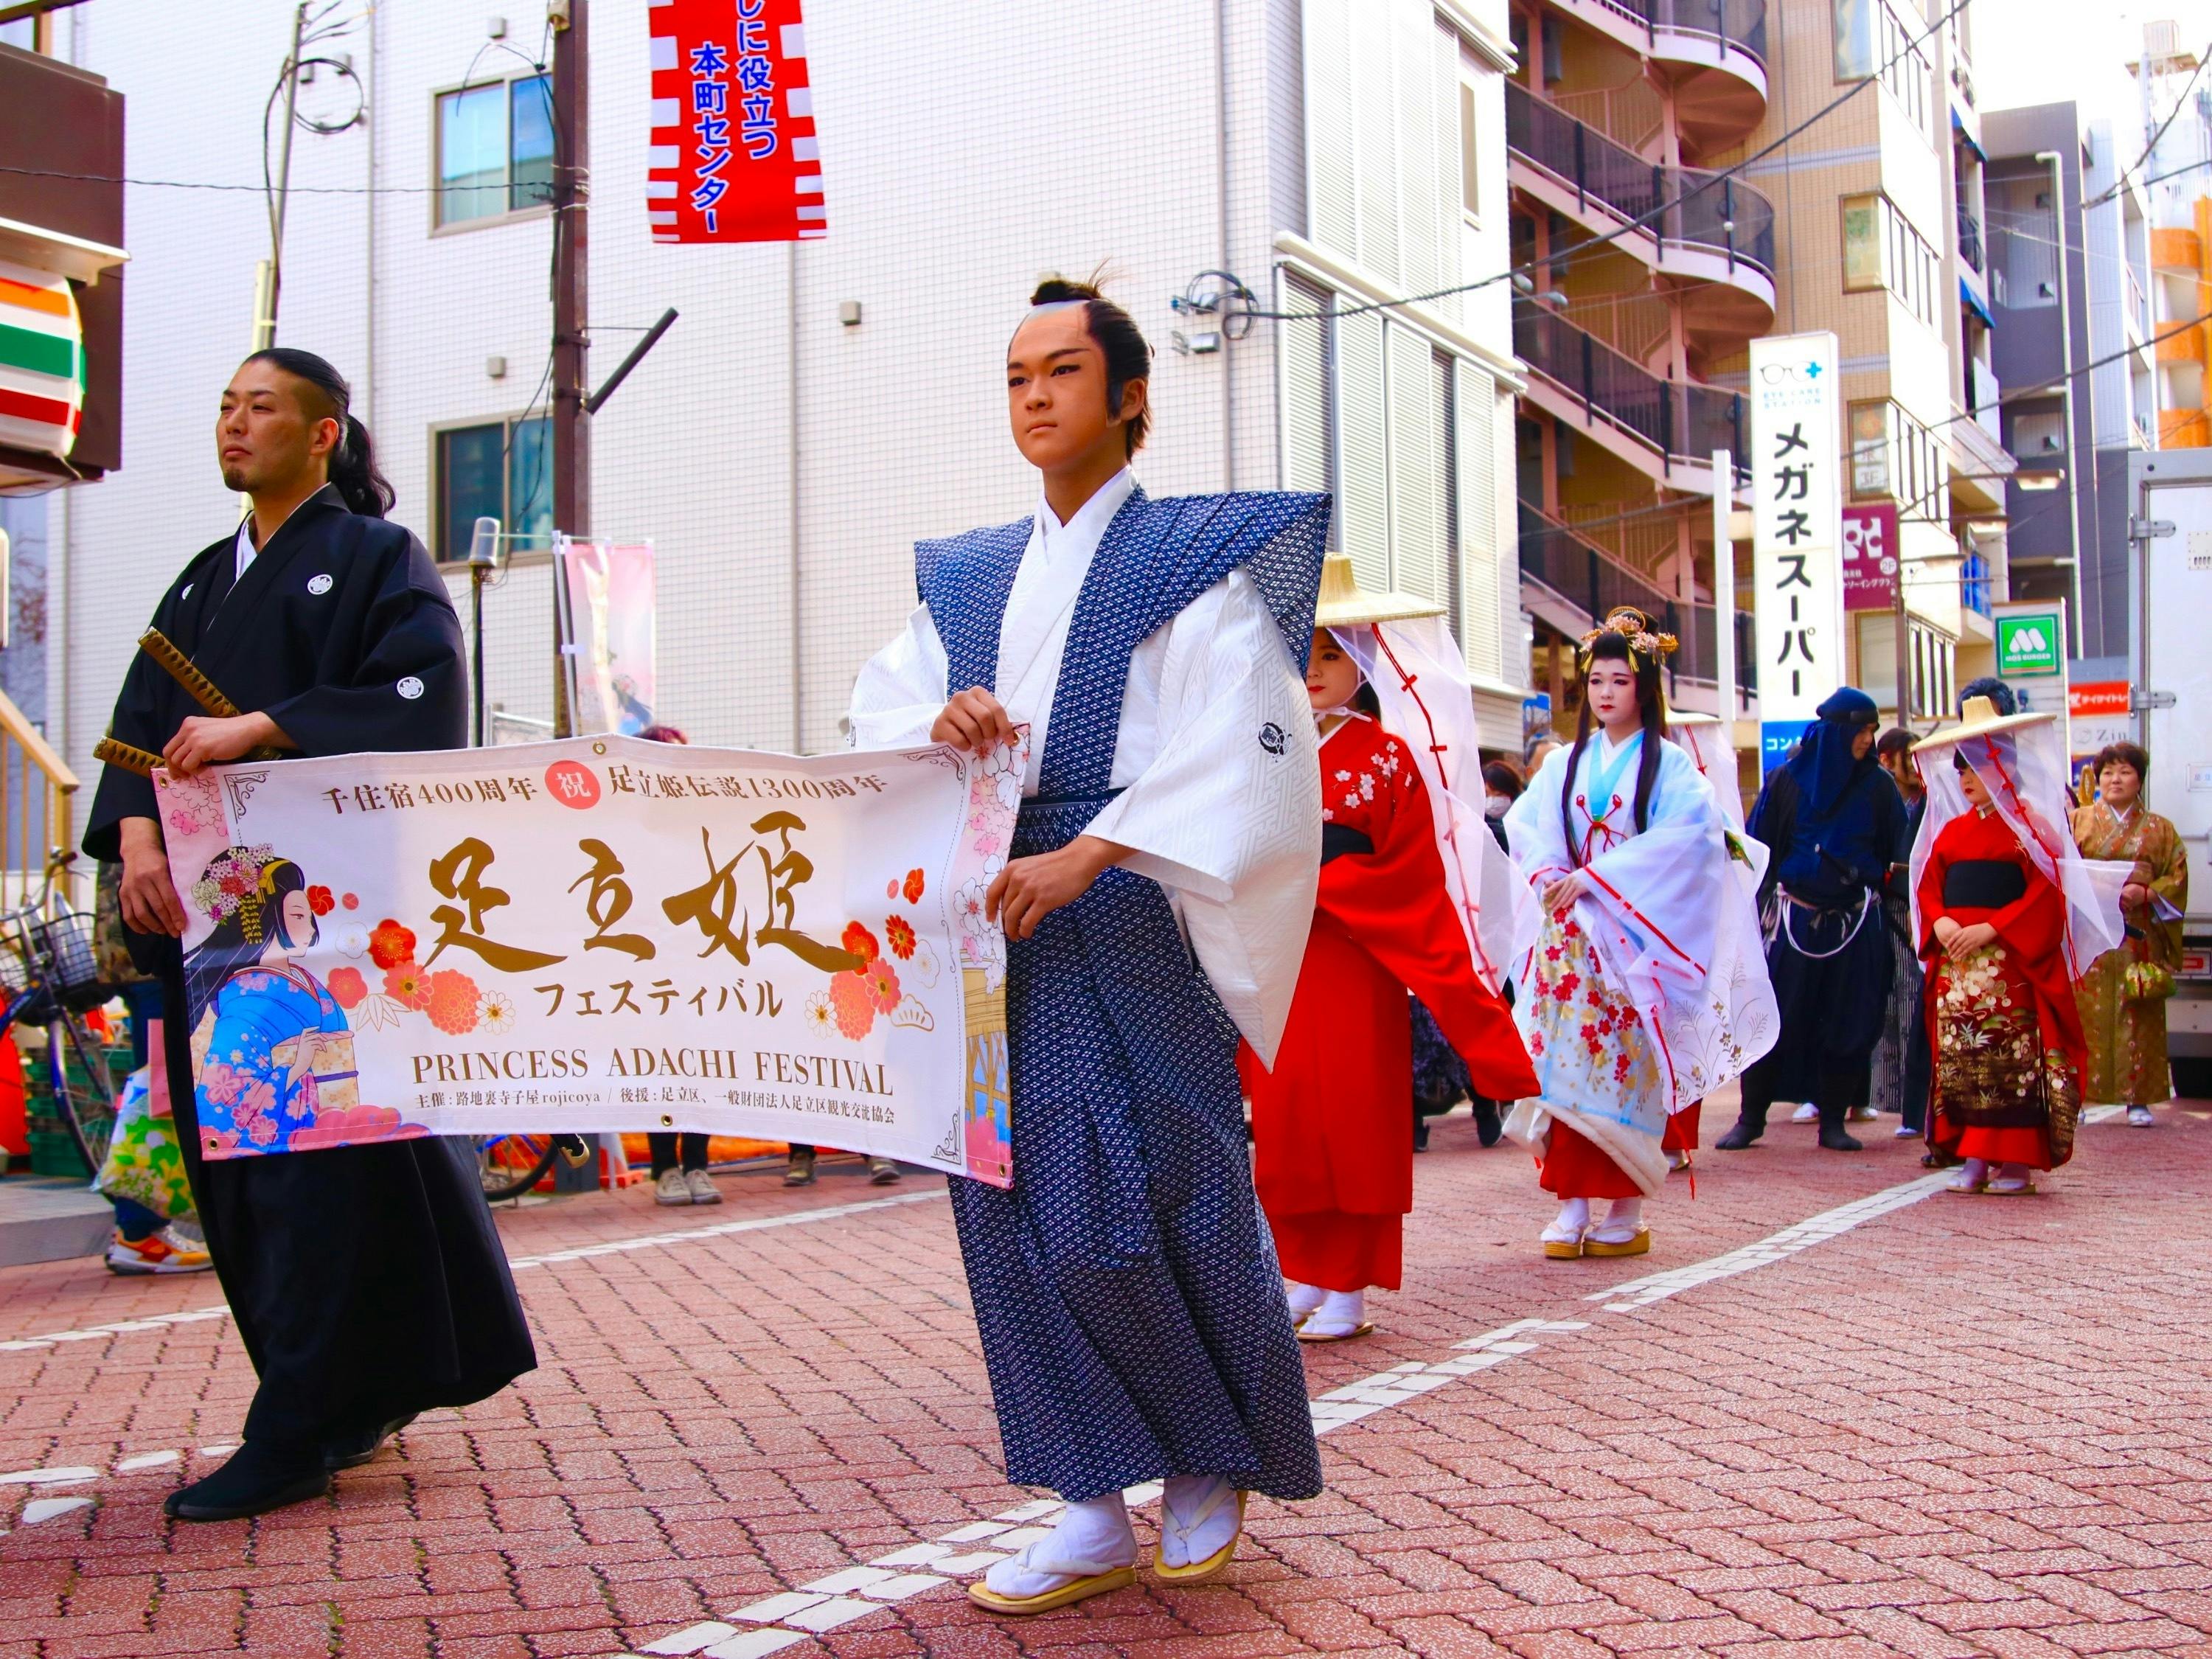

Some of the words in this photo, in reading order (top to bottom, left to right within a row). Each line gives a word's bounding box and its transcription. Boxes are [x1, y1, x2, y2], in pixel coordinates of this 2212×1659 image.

[690, 41, 733, 234] 本町センター
[1774, 422, 1815, 697] メガネスーパー
[321, 777, 538, 814] 千住宿400周年
[556, 771, 591, 798] 祝
[608, 764, 888, 799] 足立姫伝説1300周年
[422, 810, 866, 973] 足立姫
[533, 977, 783, 1018] フェスティバル
[411, 1048, 588, 1085] PRINCESS
[606, 1047, 739, 1079] ADACHI
[753, 1051, 894, 1096] FESTIVAL
